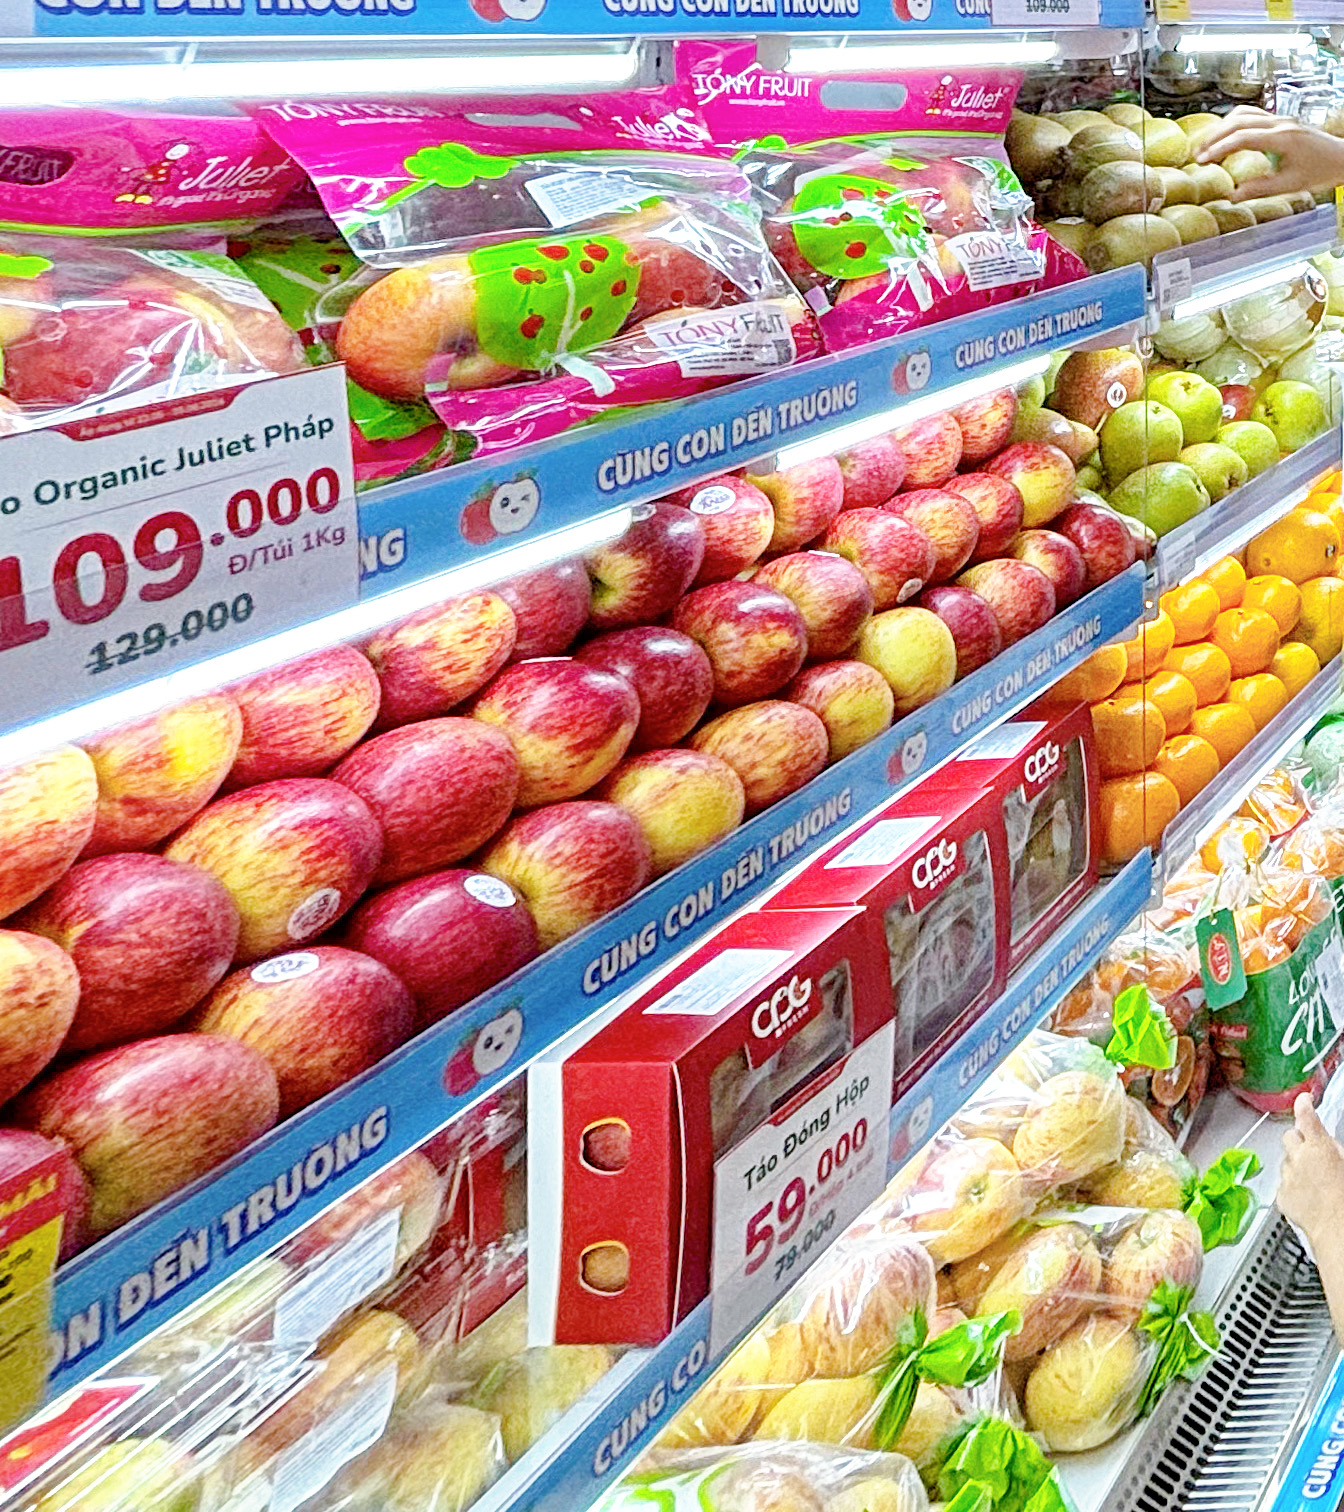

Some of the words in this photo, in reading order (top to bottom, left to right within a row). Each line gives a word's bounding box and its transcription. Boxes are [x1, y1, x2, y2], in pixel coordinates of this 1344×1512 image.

[758, 76, 812, 97] FRUIT
[950, 83, 1005, 110] Juliet
[179, 156, 293, 190] Juliet
[997, 327, 1026, 358] CON
[34, 456, 166, 506] Organic
[174, 437, 256, 473] Juliet
[264, 413, 335, 449] Pháp
[675, 428, 728, 476] CON
[0, 467, 340, 653] 109.000
[228, 537, 294, 576] Đ/Túi
[302, 525, 346, 553] 1Kg
[85, 592, 256, 675] 129.000
[995, 674, 1022, 707] CON
[663, 884, 715, 941] CON
[743, 1155, 778, 1192] Táo
[784, 1107, 831, 1159] Đóng
[836, 1076, 870, 1115] Hộp
[744, 1117, 869, 1277] 59.000
[774, 1208, 837, 1282] 79.000
